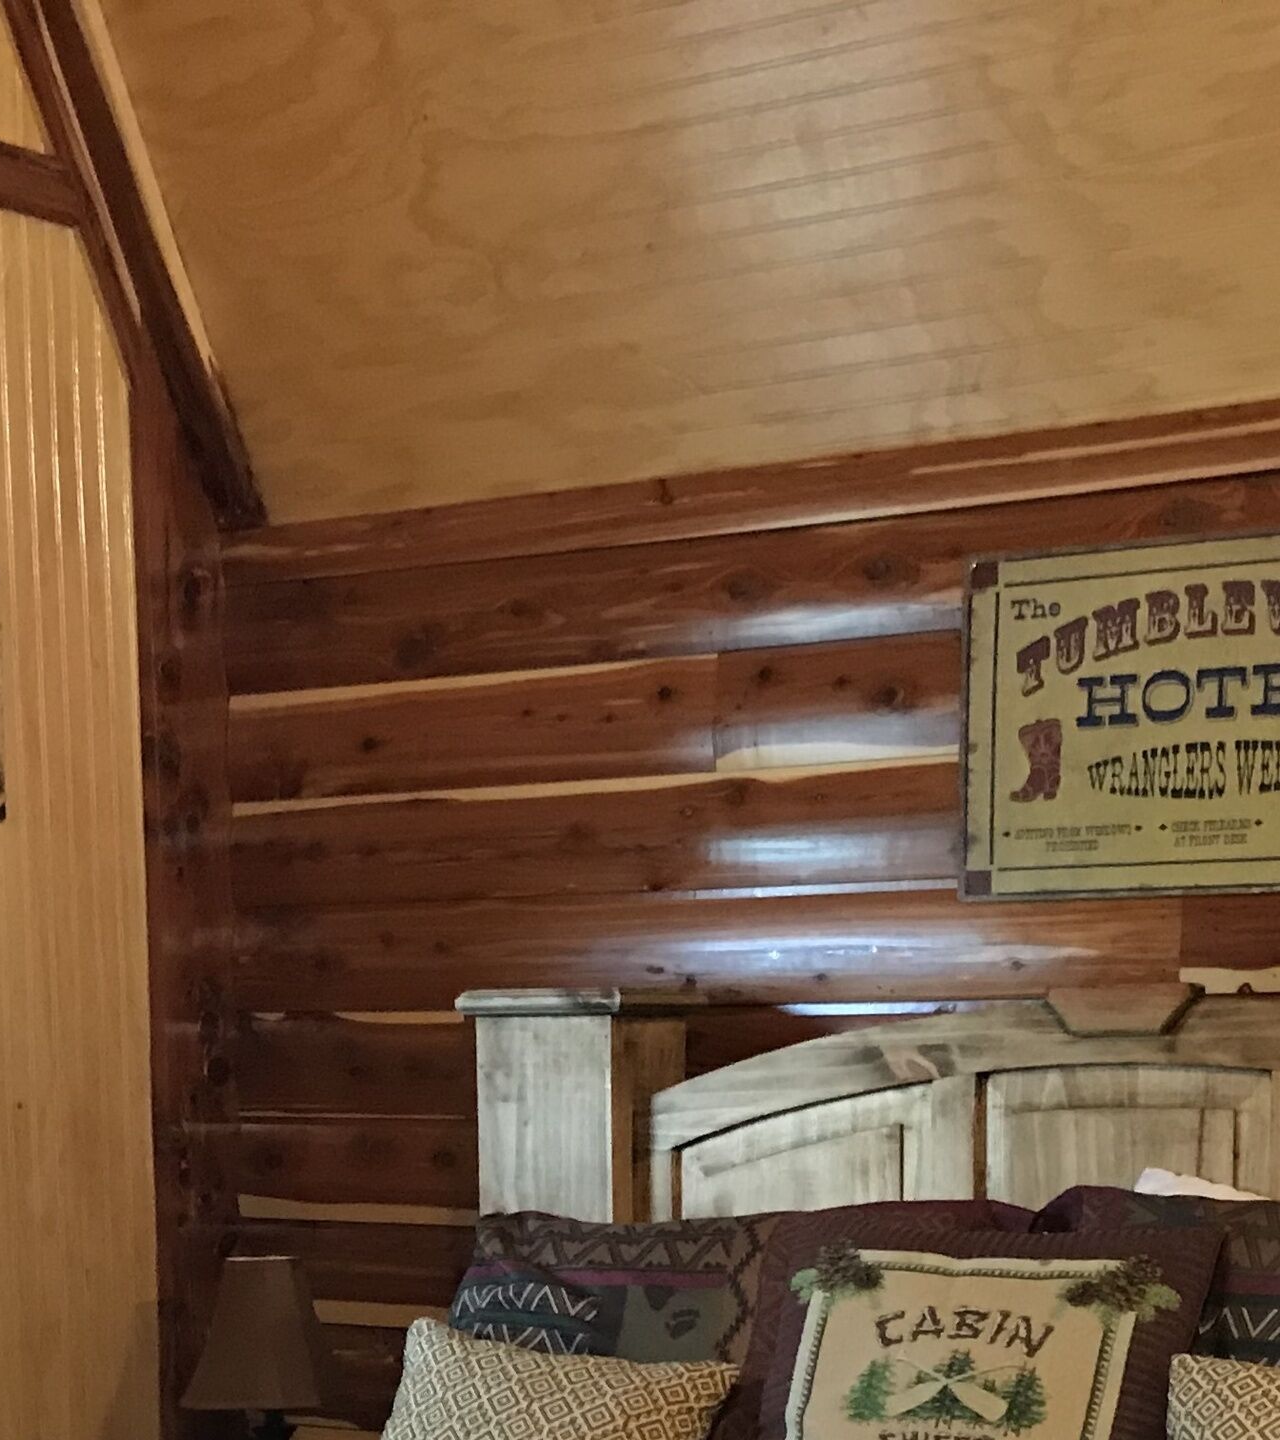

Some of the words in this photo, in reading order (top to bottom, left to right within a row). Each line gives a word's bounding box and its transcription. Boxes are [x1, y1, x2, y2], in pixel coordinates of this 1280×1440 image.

[1010, 596, 1062, 621] The
[1087, 740, 1227, 800] WRANGLERS
[874, 1304, 1055, 1359] CABIN
